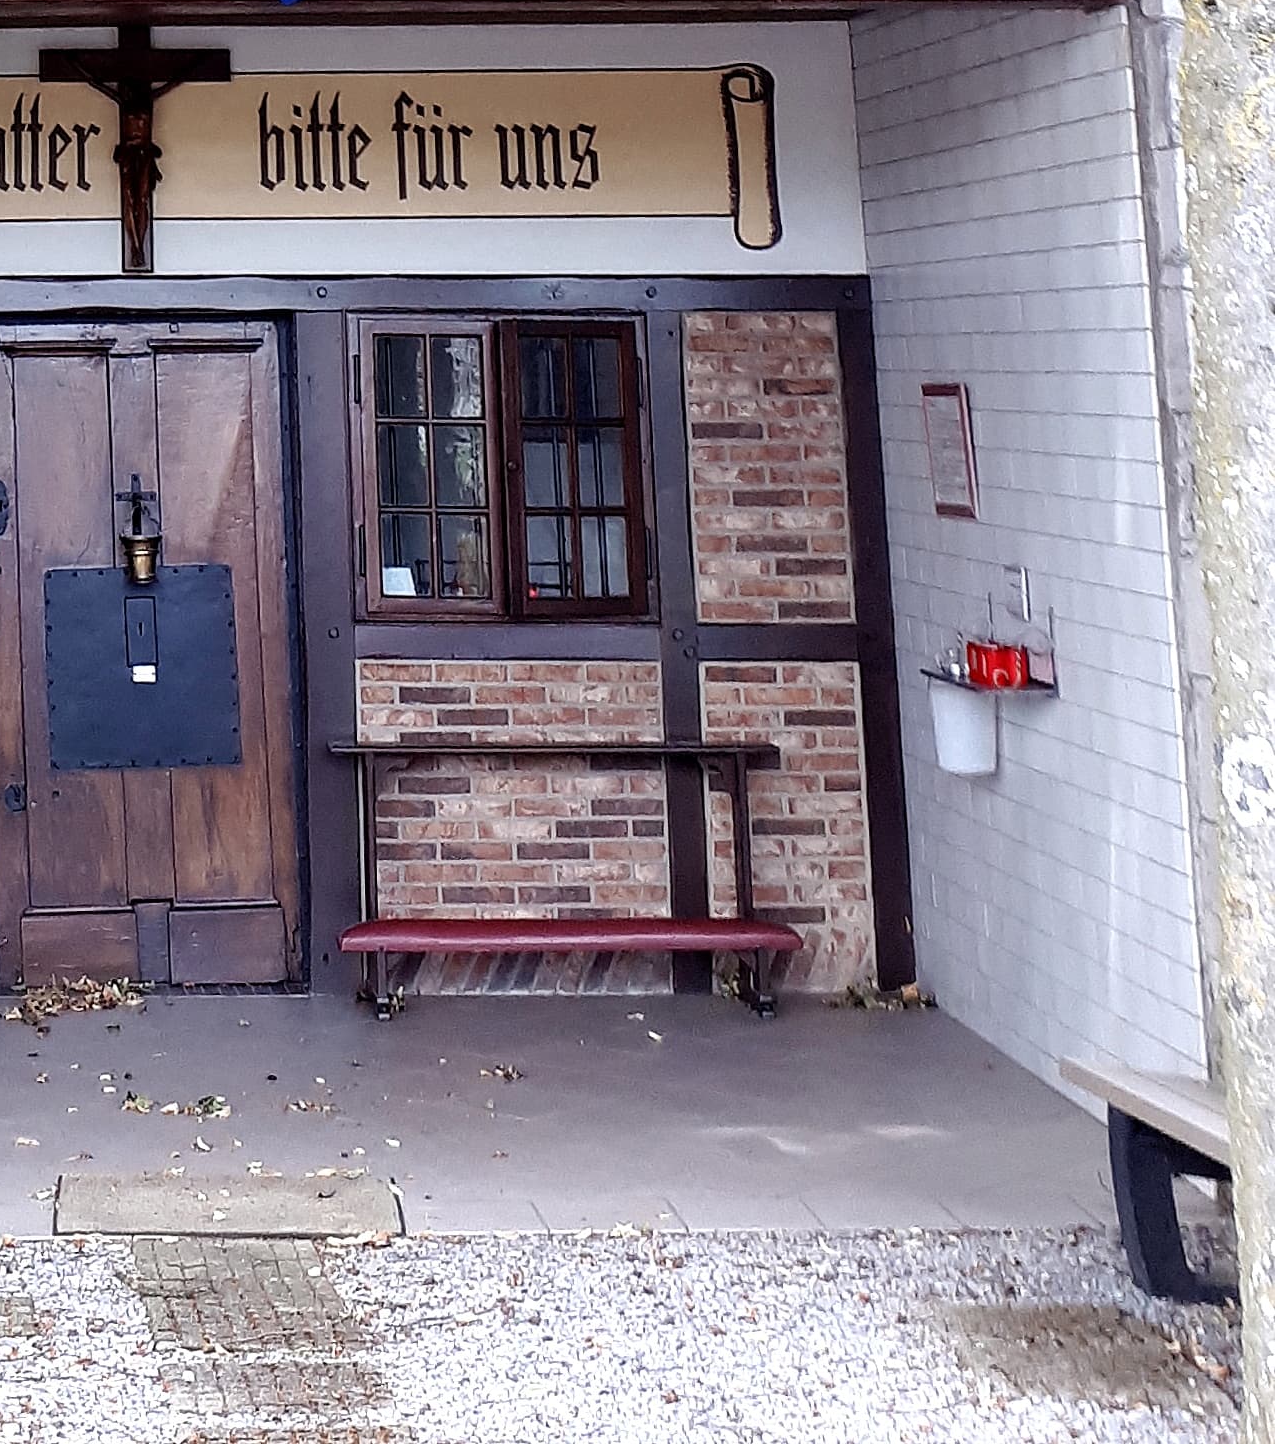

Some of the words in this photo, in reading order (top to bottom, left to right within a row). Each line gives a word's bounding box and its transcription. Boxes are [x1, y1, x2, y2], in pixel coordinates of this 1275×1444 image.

[257, 91, 370, 192] bitte
[391, 91, 473, 201] für
[494, 120, 600, 191] uns
